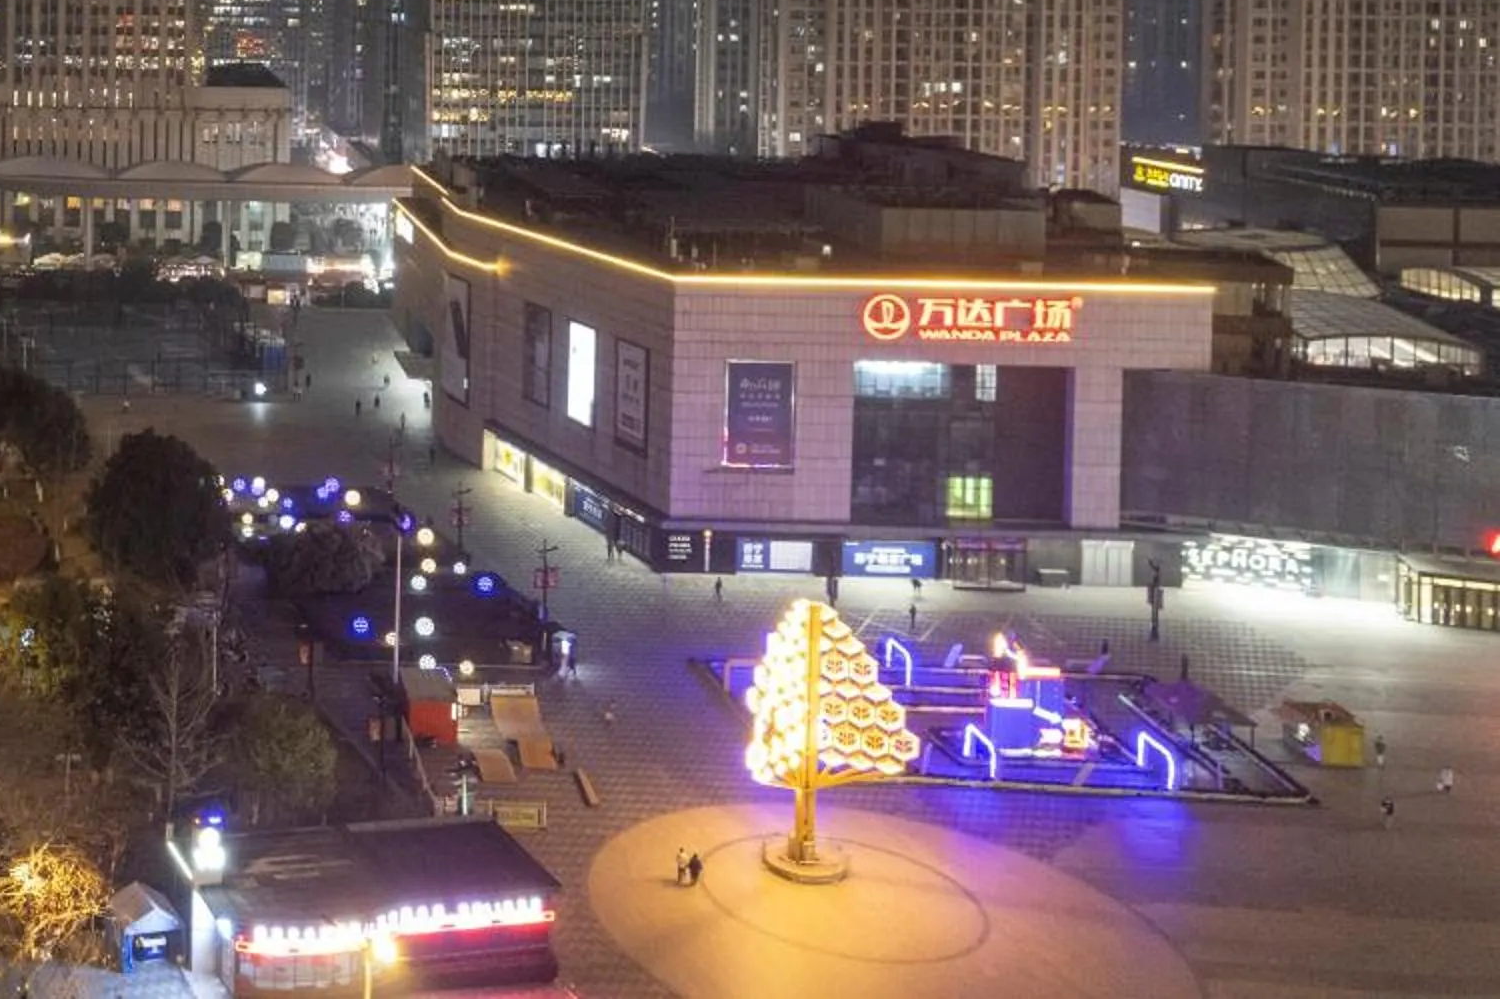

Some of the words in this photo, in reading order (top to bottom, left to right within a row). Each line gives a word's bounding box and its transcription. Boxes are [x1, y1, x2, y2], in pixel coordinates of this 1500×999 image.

[918, 298, 1072, 328] 万达广场
[918, 329, 995, 341] WANDA
[1000, 330, 1071, 342] PLAZA
[1187, 547, 1299, 575] SEPHORA
